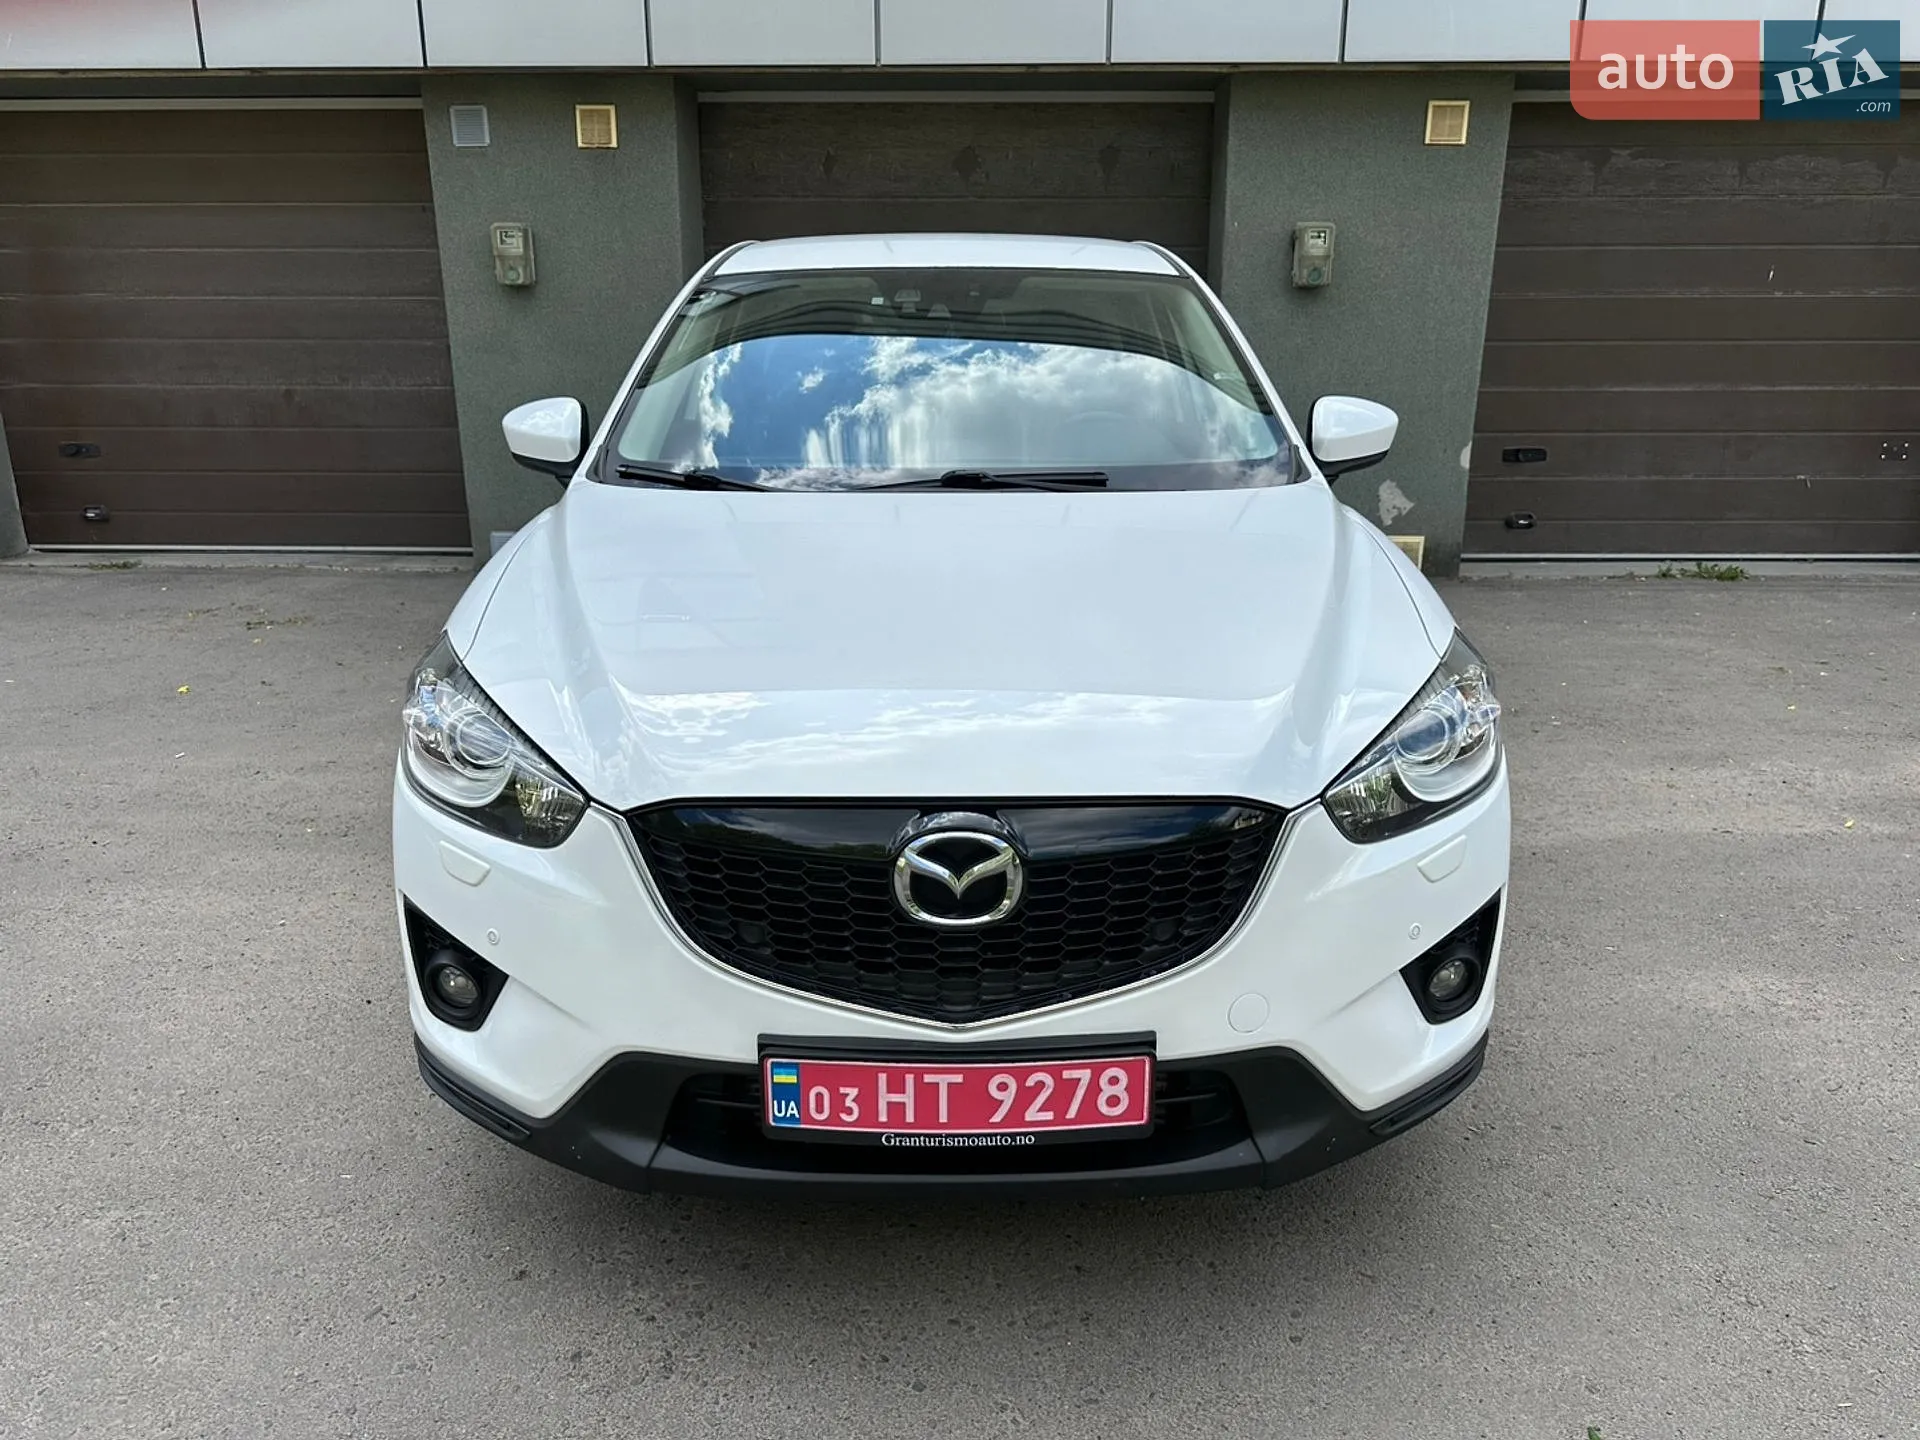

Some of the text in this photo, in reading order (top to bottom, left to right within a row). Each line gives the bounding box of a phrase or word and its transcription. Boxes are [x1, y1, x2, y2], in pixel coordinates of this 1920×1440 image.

[808, 1067, 1130, 1124] 03 HT 9278
[773, 1099, 800, 1119] UA
[881, 1132, 1036, 1147] Granturismoauto.no
